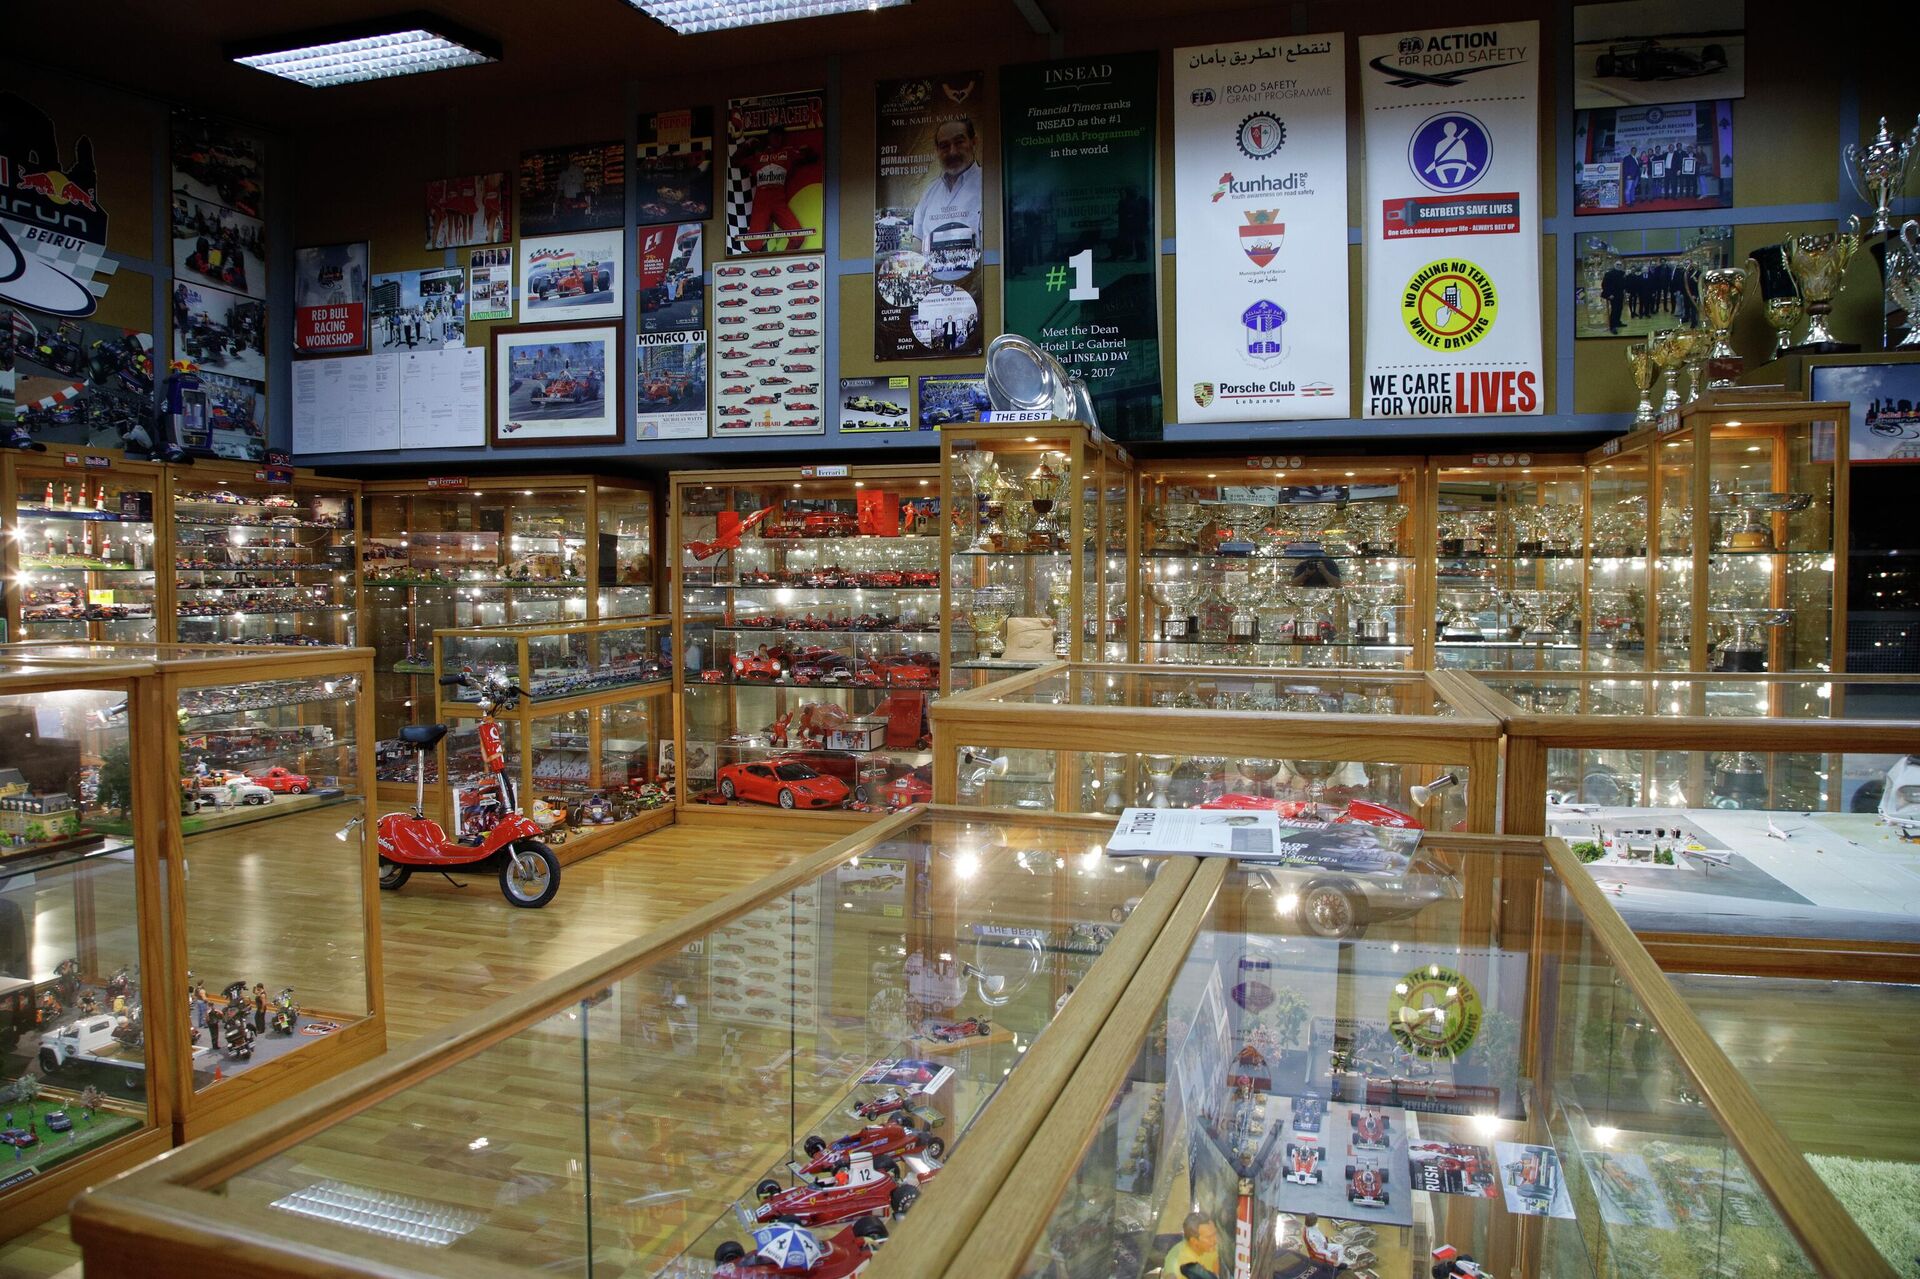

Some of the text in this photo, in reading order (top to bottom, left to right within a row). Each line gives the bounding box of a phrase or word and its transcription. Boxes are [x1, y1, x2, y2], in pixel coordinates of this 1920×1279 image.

[1427, 31, 1497, 52] ACTION
[1189, 42, 1331, 68] لنقطع الطريق بأمان
[1398, 47, 1527, 67] FOR ROAD SAFETY
[1045, 64, 1113, 83] INSEAD
[1226, 79, 1298, 94] ROAD SAFETY
[1226, 87, 1332, 104] GRANT PROGRAMME
[1027, 99, 1132, 117] Financial Times ranks
[937, 113, 967, 122] KARAM
[1037, 114, 1121, 131] INSEAD as the #1
[1056, 131, 1079, 143] MBA
[880, 145, 898, 154] 2017
[1050, 145, 1109, 158] in the world
[880, 165, 929, 176] SPORTS ICON
[1229, 173, 1298, 193] kunhadi
[1297, 189, 1315, 197] safety
[1420, 203, 1513, 218] SEATBELTS SAVE LIVES
[1400, 227, 1414, 235] click
[1414, 226, 1430, 234] could
[1445, 226, 1458, 234] your
[26, 227, 86, 252] BEIRUT
[1045, 248, 1100, 301] #1
[1405, 262, 1495, 308] NO DIALING NO TEXTING
[311, 307, 348, 321] RED BULL
[314, 322, 346, 334] RACING
[1042, 325, 1119, 338] Meet the Dean
[1409, 317, 1489, 348] WHILE DRIVING
[305, 333, 353, 347] WORKSHOP
[639, 331, 704, 345] MONACO, 01
[1039, 338, 1127, 351] Hotel Le Gabriel
[1074, 352, 1108, 362] INSEAD
[1110, 351, 1130, 361] DAY
[1070, 368, 1082, 379] 29
[1091, 367, 1116, 378] 2017
[1219, 381, 1296, 394] Porsche Club
[1370, 372, 1451, 396] WE CARE
[1455, 371, 1537, 414] LIVES
[1371, 395, 1452, 416] FOR YOUR
[994, 412, 1048, 421] THE BEST
[859, 1168, 872, 1182] 12
[1425, 1164, 1441, 1193] RUSH
